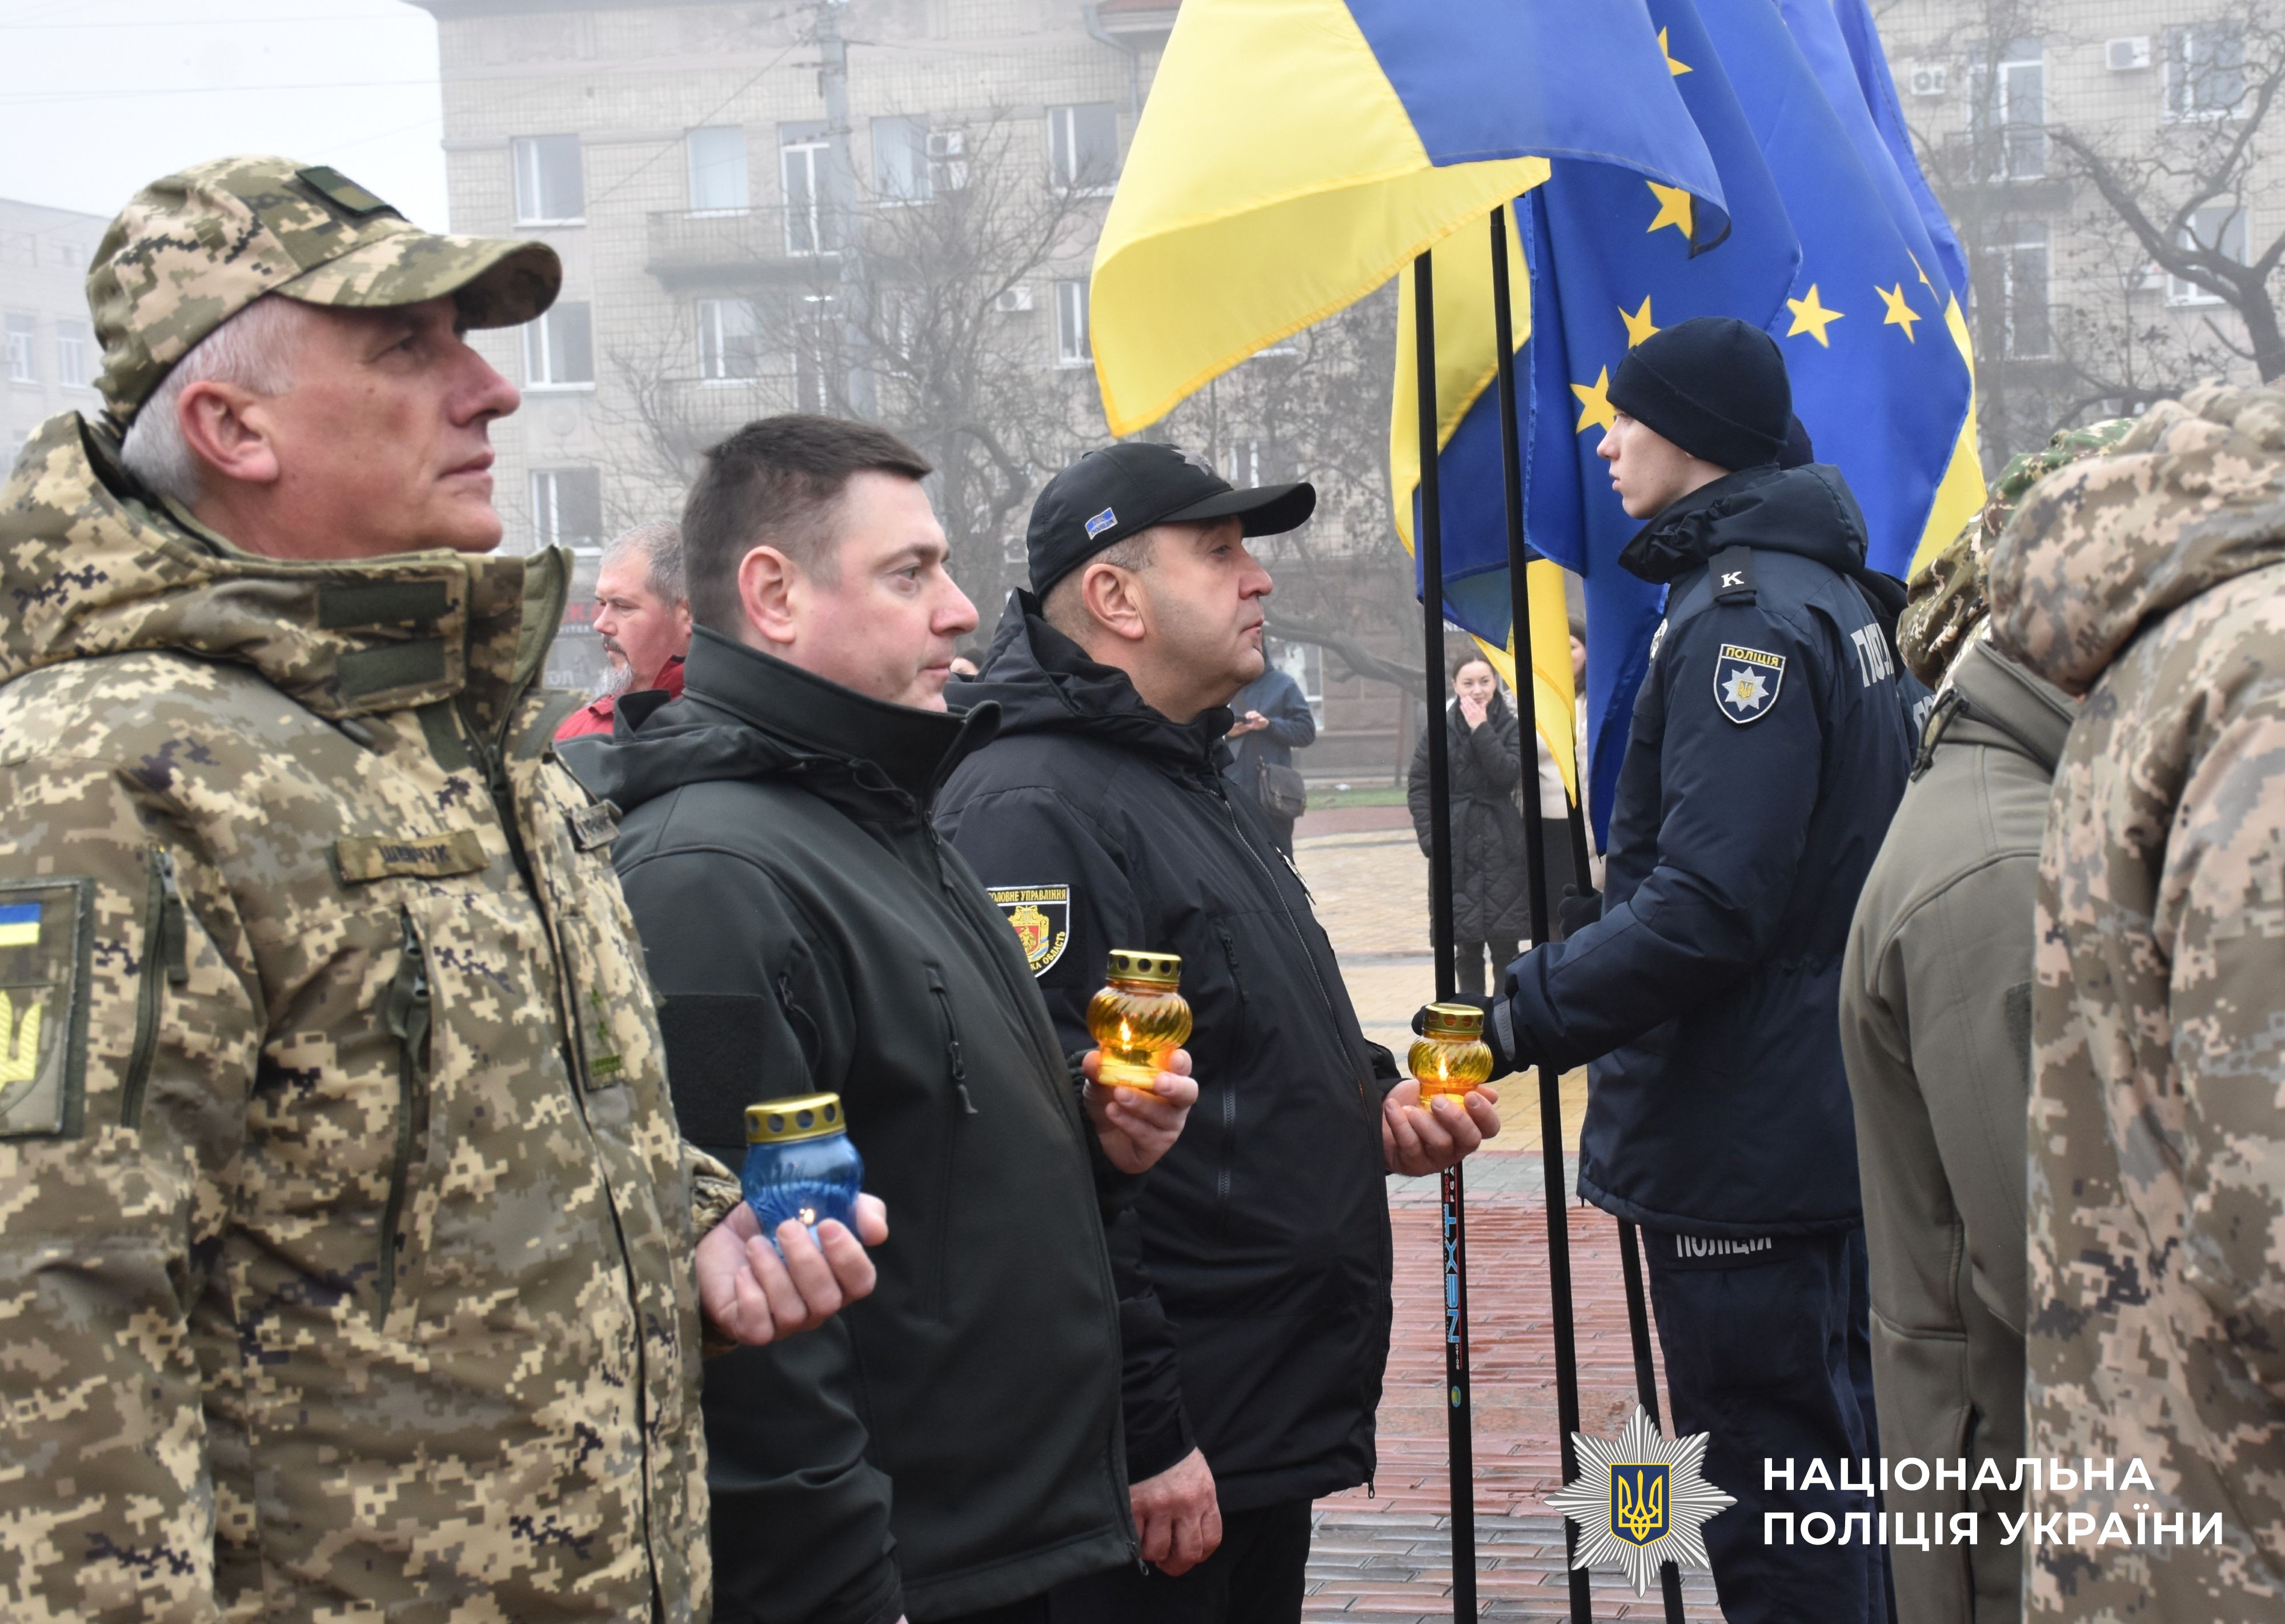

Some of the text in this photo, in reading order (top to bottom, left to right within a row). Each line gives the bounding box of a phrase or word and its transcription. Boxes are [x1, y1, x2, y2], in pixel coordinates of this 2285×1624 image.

[1725, 647, 1779, 667] ПОЛІЦІЯ
[1850, 623, 1895, 688] ПОЛ
[1020, 889, 1067, 901] УПРАВЛІННЯ
[1042, 931, 1066, 964] ОБЛАСТЬ
[1444, 1203, 1460, 1343] NEXT
